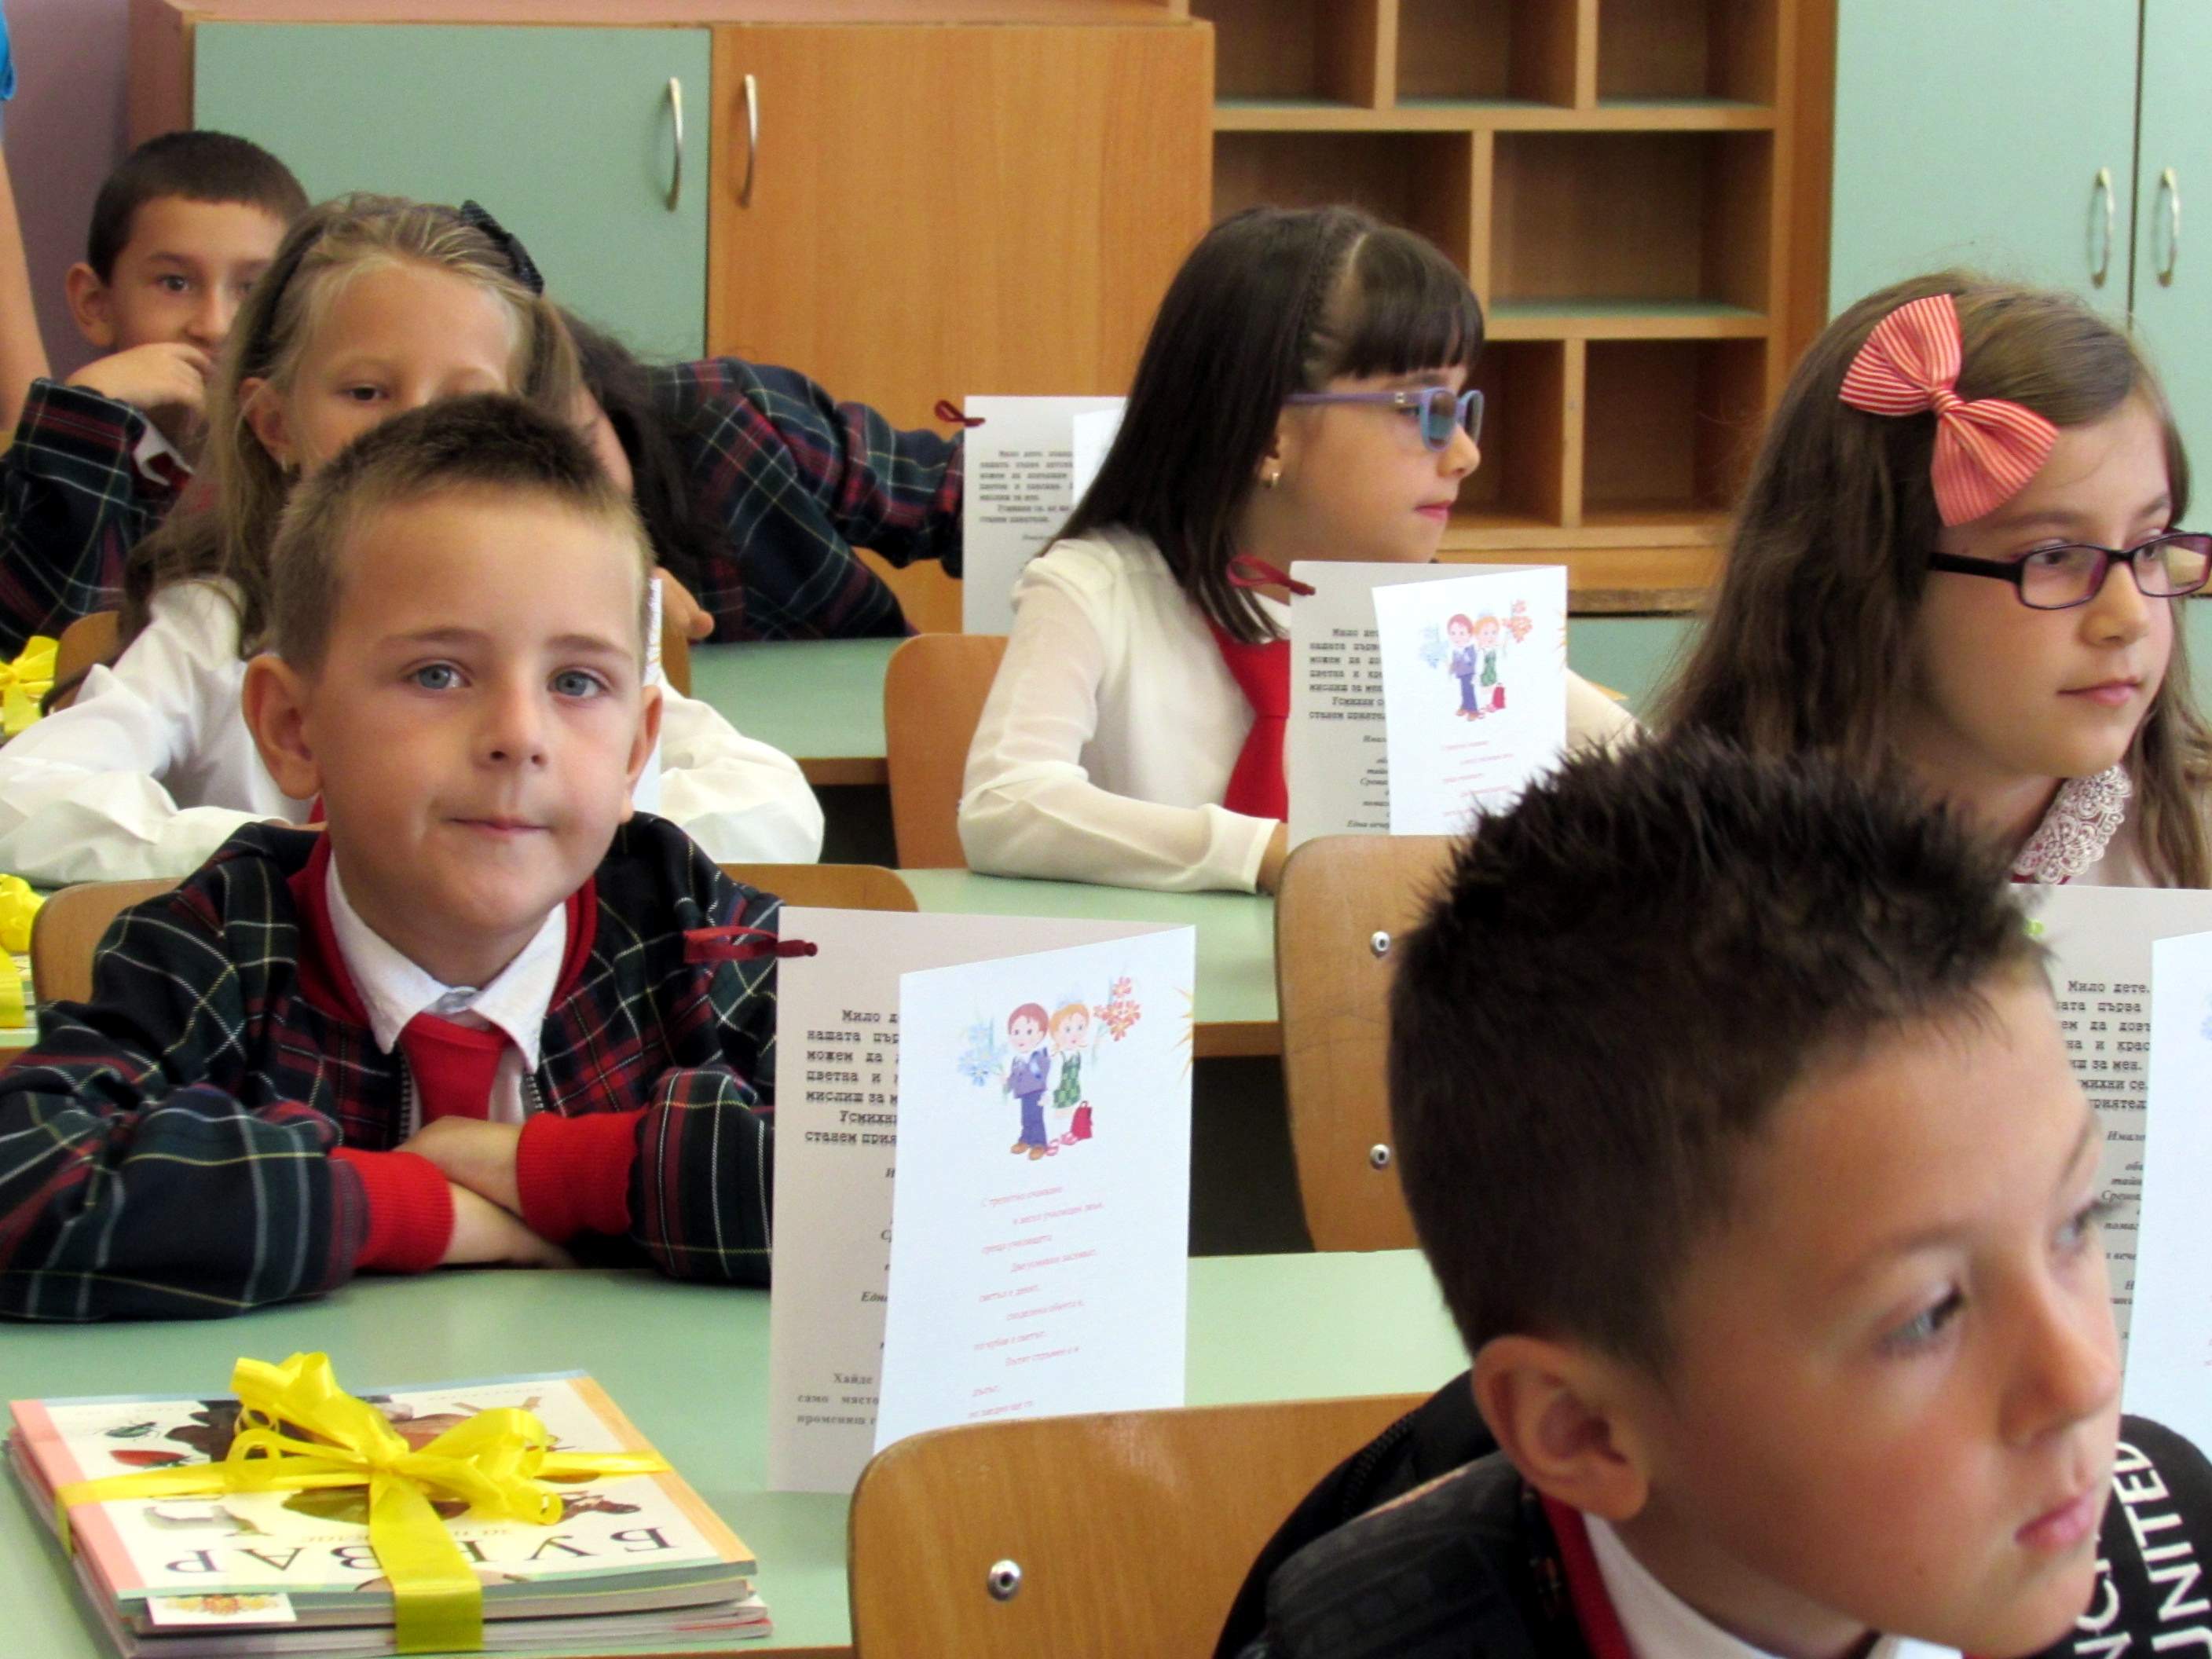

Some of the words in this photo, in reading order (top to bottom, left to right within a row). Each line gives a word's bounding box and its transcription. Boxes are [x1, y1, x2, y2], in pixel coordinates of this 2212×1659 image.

[2067, 980, 2106, 992] Мило
[2097, 1002, 2141, 1013] първа
[841, 1009, 881, 1023] Мило
[2089, 1021, 2108, 1031] да
[807, 1030, 862, 1042] нашата
[806, 1050, 854, 1062] можем
[865, 1052, 883, 1063] да
[2091, 1060, 2108, 1070] за
[806, 1070, 859, 1083] цветна
[871, 1073, 881, 1083] и
[806, 1090, 863, 1104] мислиш
[868, 1093, 885, 1104] за
[804, 1130, 857, 1143] станем
